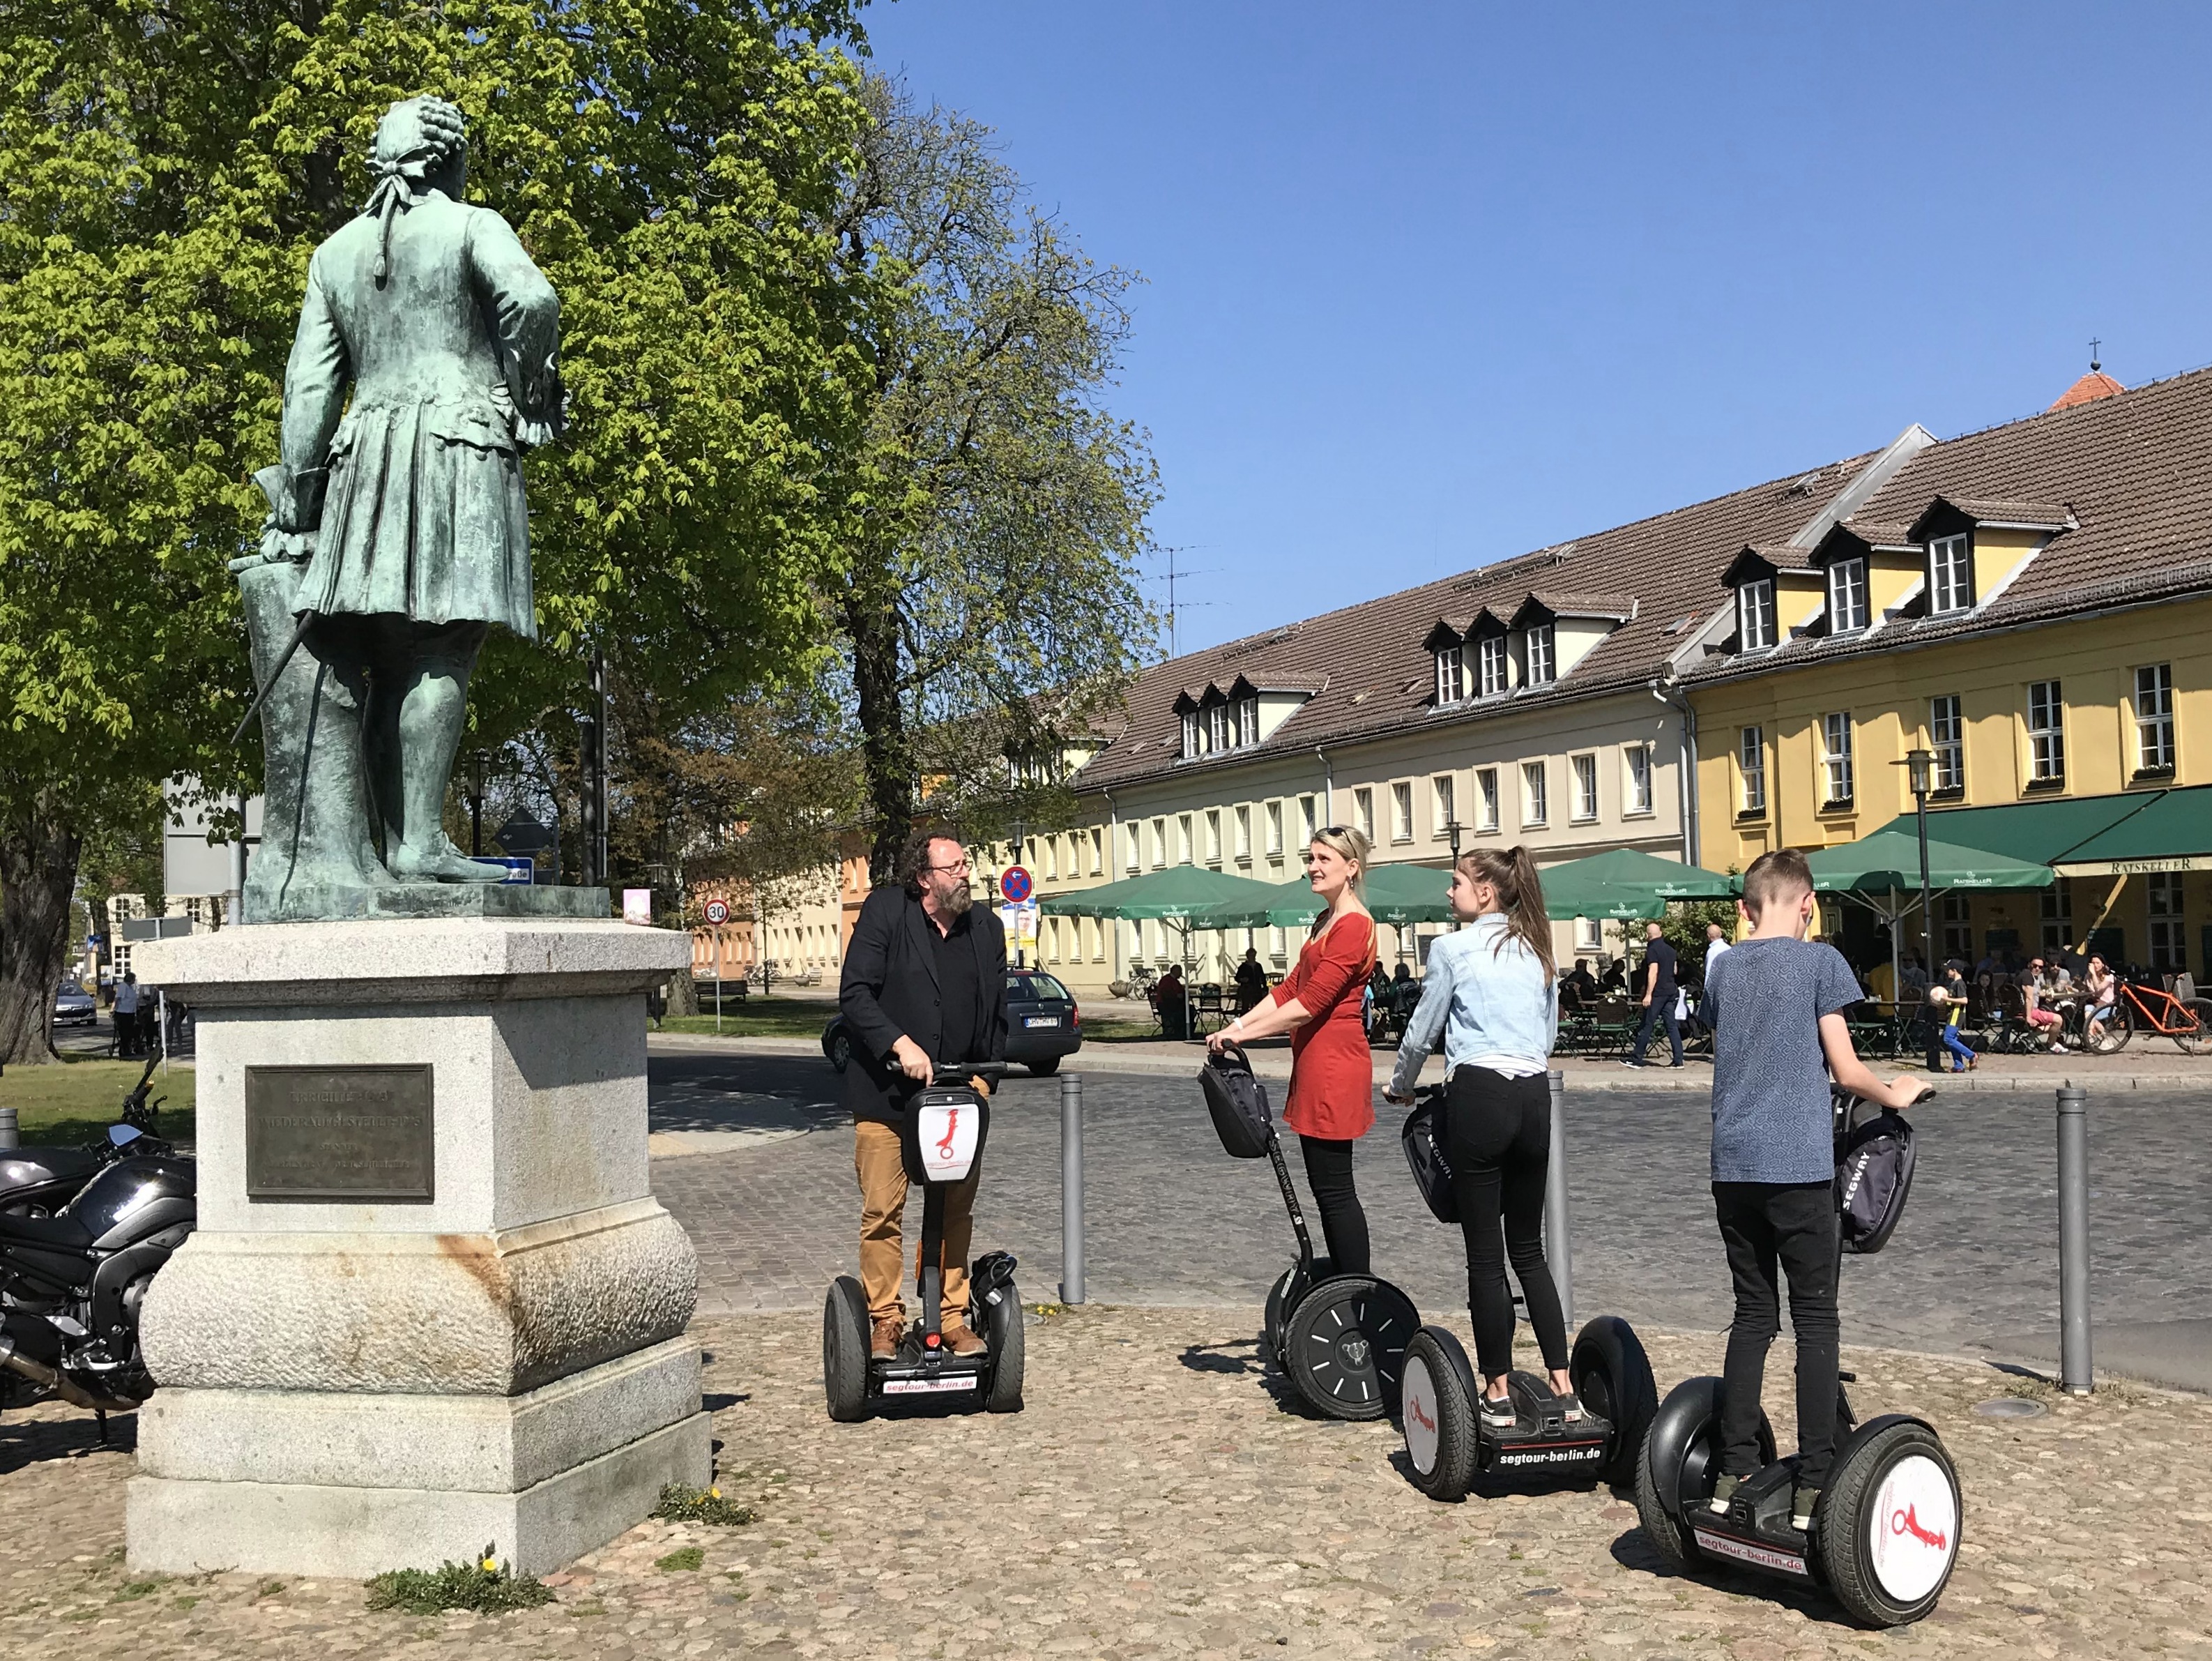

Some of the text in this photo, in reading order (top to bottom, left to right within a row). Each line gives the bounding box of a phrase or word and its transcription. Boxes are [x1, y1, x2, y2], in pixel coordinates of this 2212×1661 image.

[2112, 857, 2190, 873] RATSKELLER
[708, 906, 725, 918] 30
[1269, 1139, 1299, 1213] SEGWAY
[1843, 1151, 1870, 1211] SEGWAY
[887, 1380, 974, 1392] segtour-berlin.de
[1500, 1448, 1601, 1466] segtour-berlin.de
[1699, 1535, 1802, 1570] segtour-berlin.de
